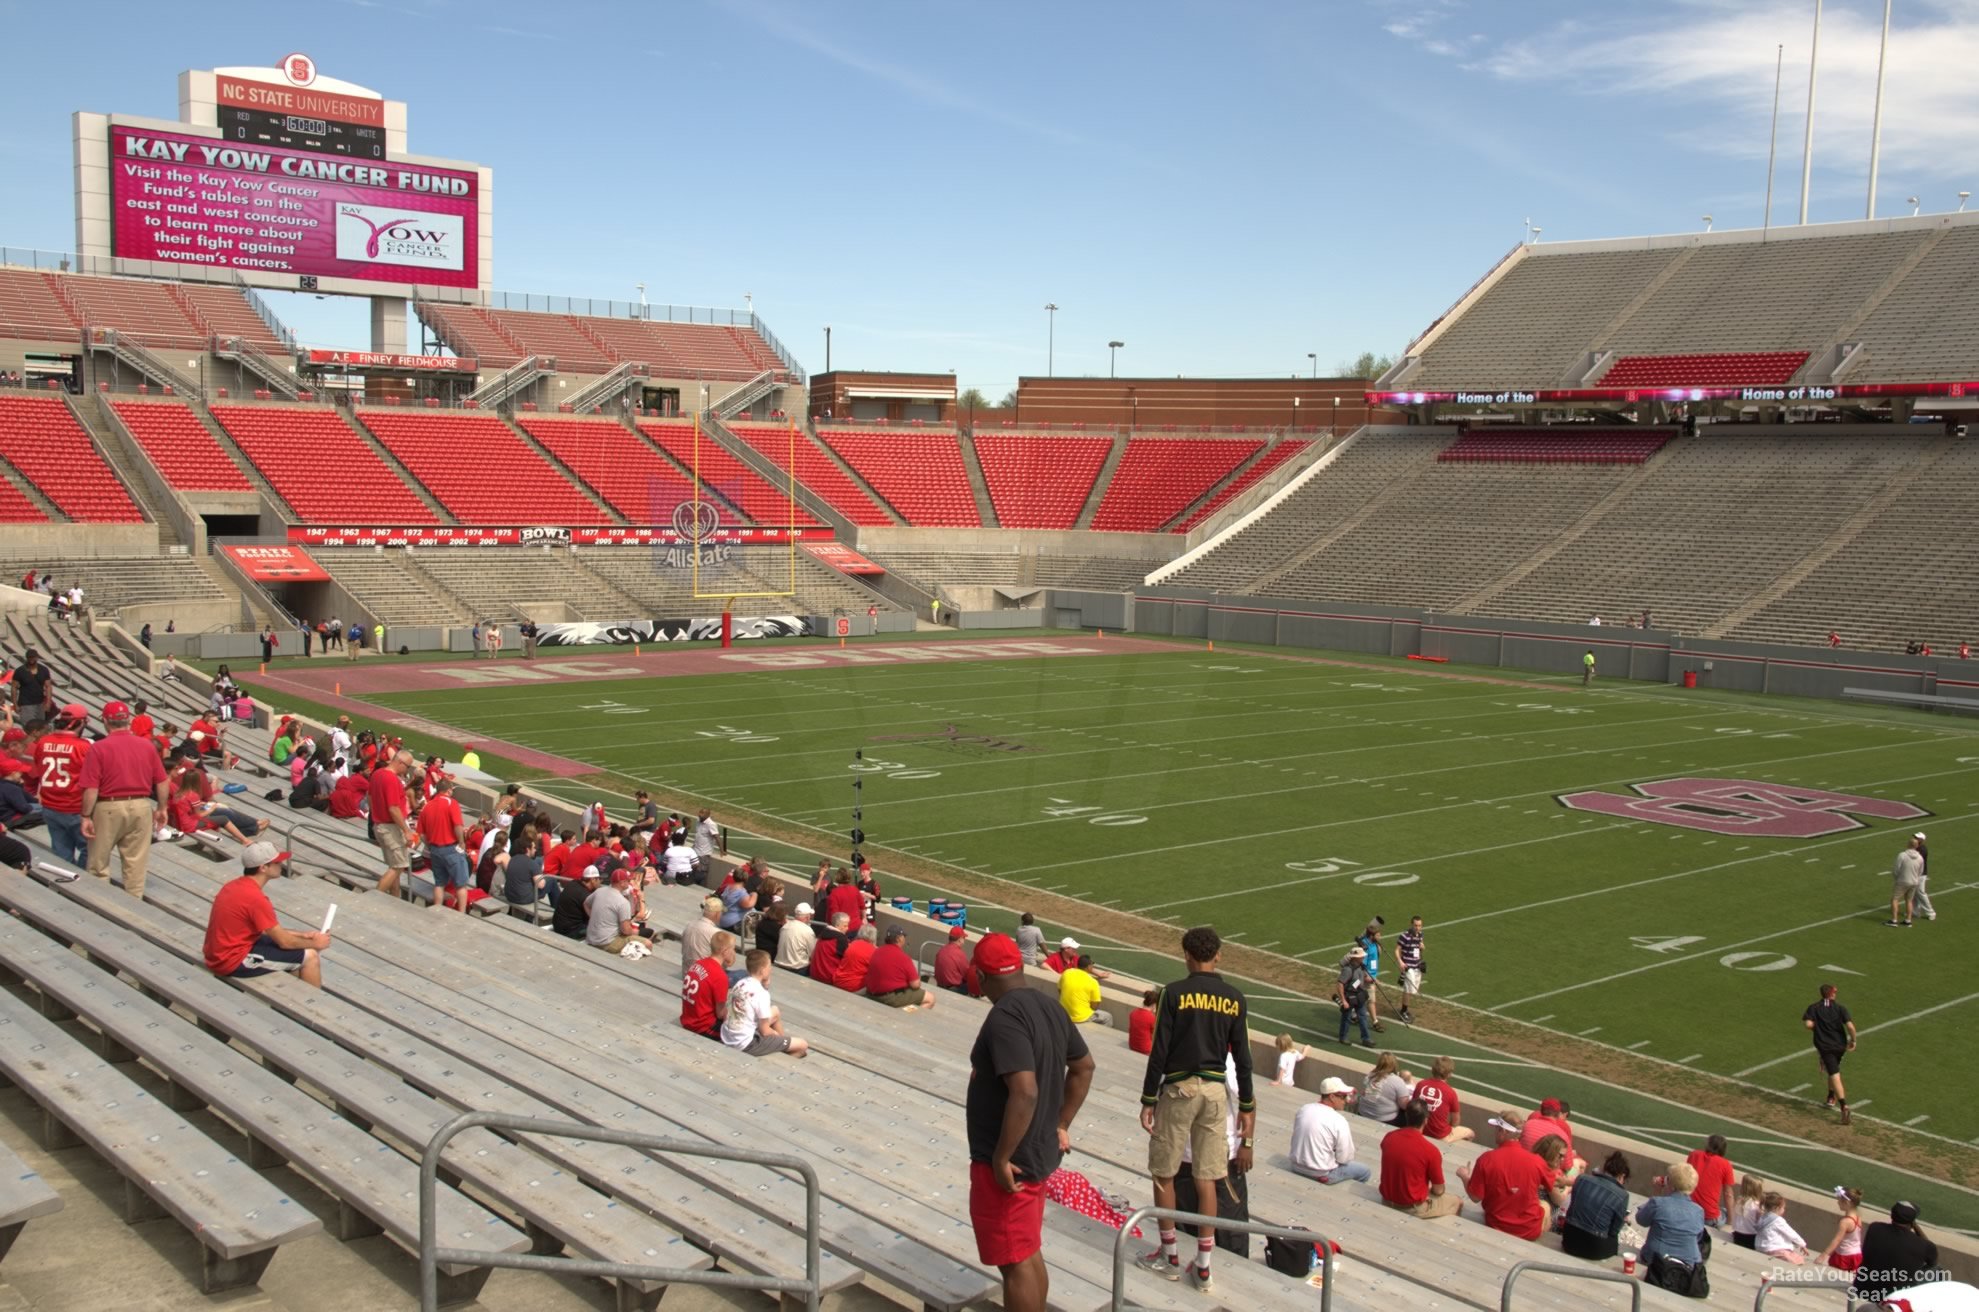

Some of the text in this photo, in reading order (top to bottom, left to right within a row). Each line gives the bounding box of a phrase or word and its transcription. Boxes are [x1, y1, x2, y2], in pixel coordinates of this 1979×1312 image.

[223, 84, 378, 119] NC STATE UNIVERSITY
[237, 112, 250, 122] RED
[238, 126, 246, 138] 0
[289, 118, 325, 134] 60:00
[356, 128, 377, 138] WHITE
[373, 144, 380, 156] 0
[126, 136, 468, 196] KAY YOW CANCER FUND
[124, 164, 319, 198] Visit the Kay Yow Cancer
[144, 182, 302, 211] Fund's tables on the
[126, 199, 318, 228] east and west concourse
[341, 206, 362, 214] KAY
[145, 216, 302, 241] to learn more about
[154, 232, 295, 254] their fight against
[386, 241, 441, 251] CANCER
[157, 250, 293, 270] women's cancers.
[386, 248, 443, 258] FUND
[302, 276, 317, 289] 25
[332, 352, 458, 368] A.E. FINLEY FIELDHOUSE
[1457, 392, 1534, 404] Home of the
[1742, 387, 1836, 400] Home of the
[522, 528, 570, 540] BOWL
[663, 545, 732, 568] Allstate
[420, 642, 1103, 683] NC STATE
[578, 702, 650, 714] 10
[695, 728, 780, 742] 20
[41, 757, 71, 788] 25
[848, 762, 942, 779] 30
[1040, 806, 1148, 826] 40
[1285, 857, 1420, 886] 50
[1628, 936, 1798, 971] 40
[682, 975, 699, 1005] 22
[1178, 993, 1239, 1016] JAMAICA
[1427, 1087, 1436, 1096] S
